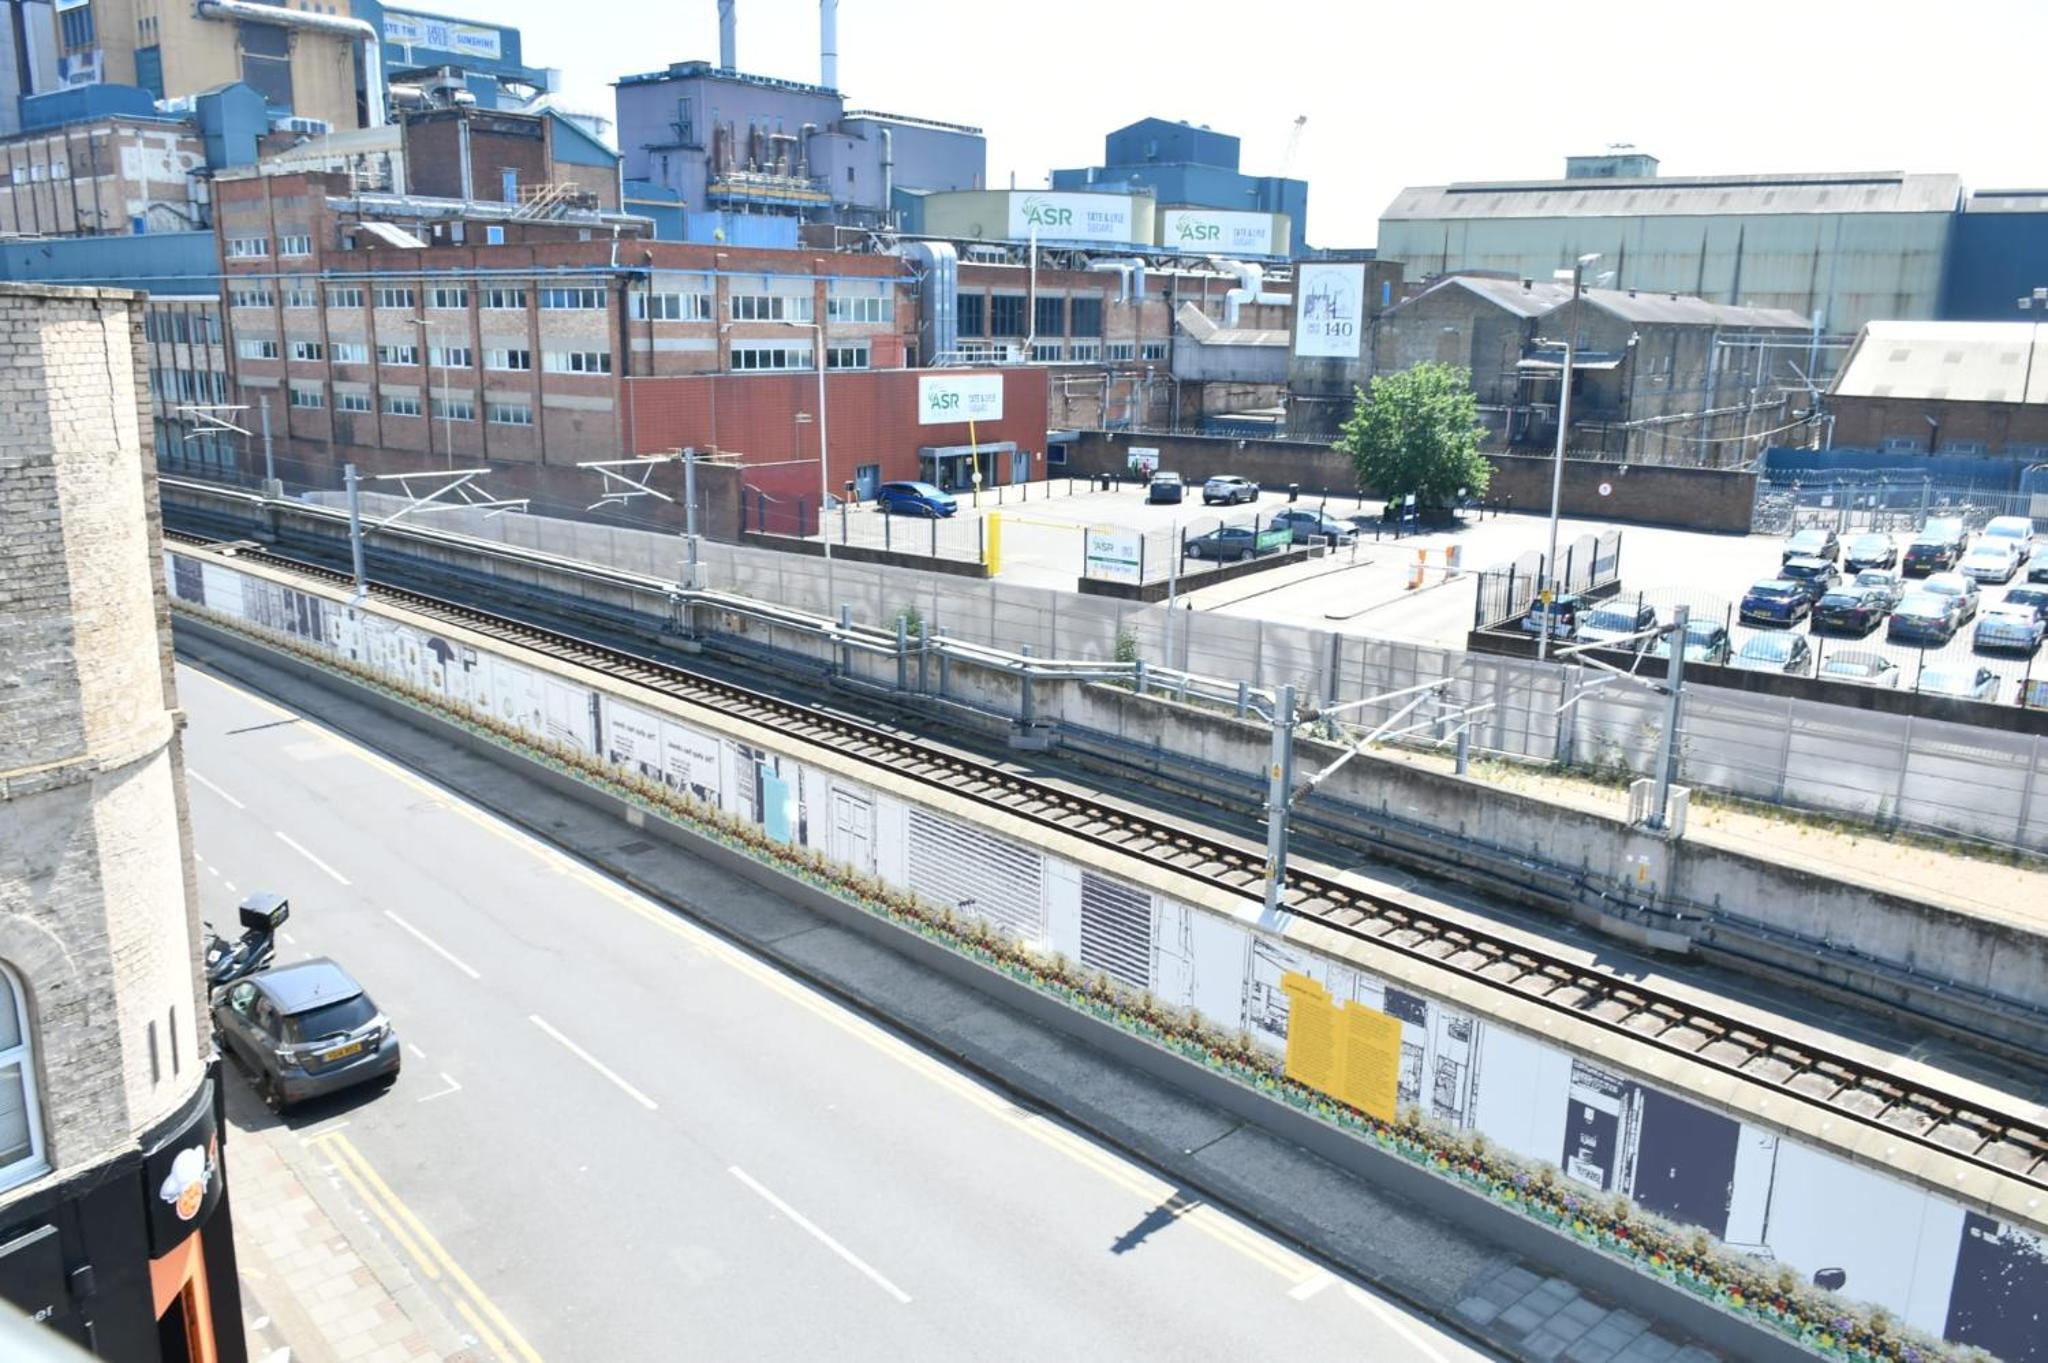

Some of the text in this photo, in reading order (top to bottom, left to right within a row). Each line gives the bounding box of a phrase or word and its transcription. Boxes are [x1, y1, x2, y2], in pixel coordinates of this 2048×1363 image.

[384, 23, 398, 35] STE
[457, 34, 494, 48] SUNSHINE
[1027, 207, 1073, 226] ASR
[1180, 224, 1220, 240] ASR
[1325, 322, 1353, 337] 140
[931, 393, 960, 410] ASR
